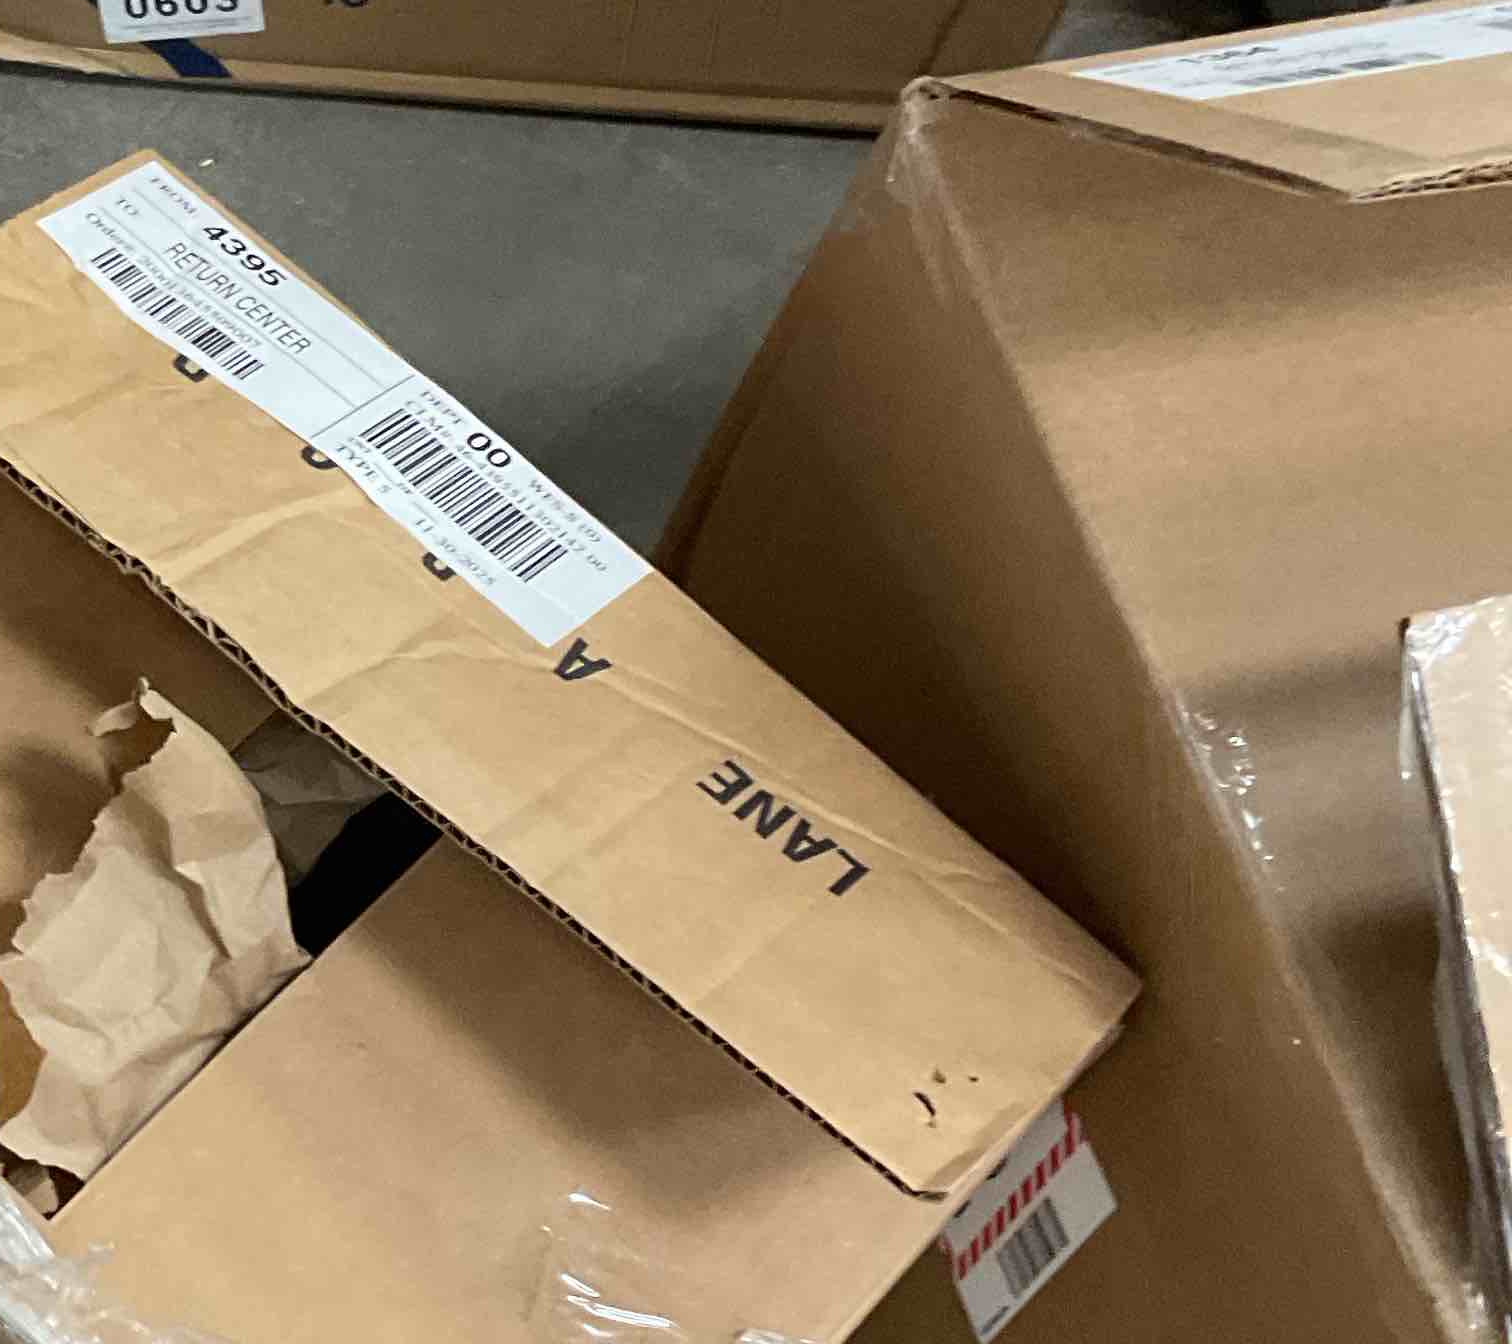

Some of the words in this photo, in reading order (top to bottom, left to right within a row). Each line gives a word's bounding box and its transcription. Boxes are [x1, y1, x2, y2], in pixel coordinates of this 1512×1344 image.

[202, 225, 288, 288] 4395
[162, 241, 237, 300] RETURN
[235, 295, 312, 354] CENTER
[466, 431, 512, 468] 00
[552, 637, 612, 682] A
[695, 758, 871, 897] LANE
